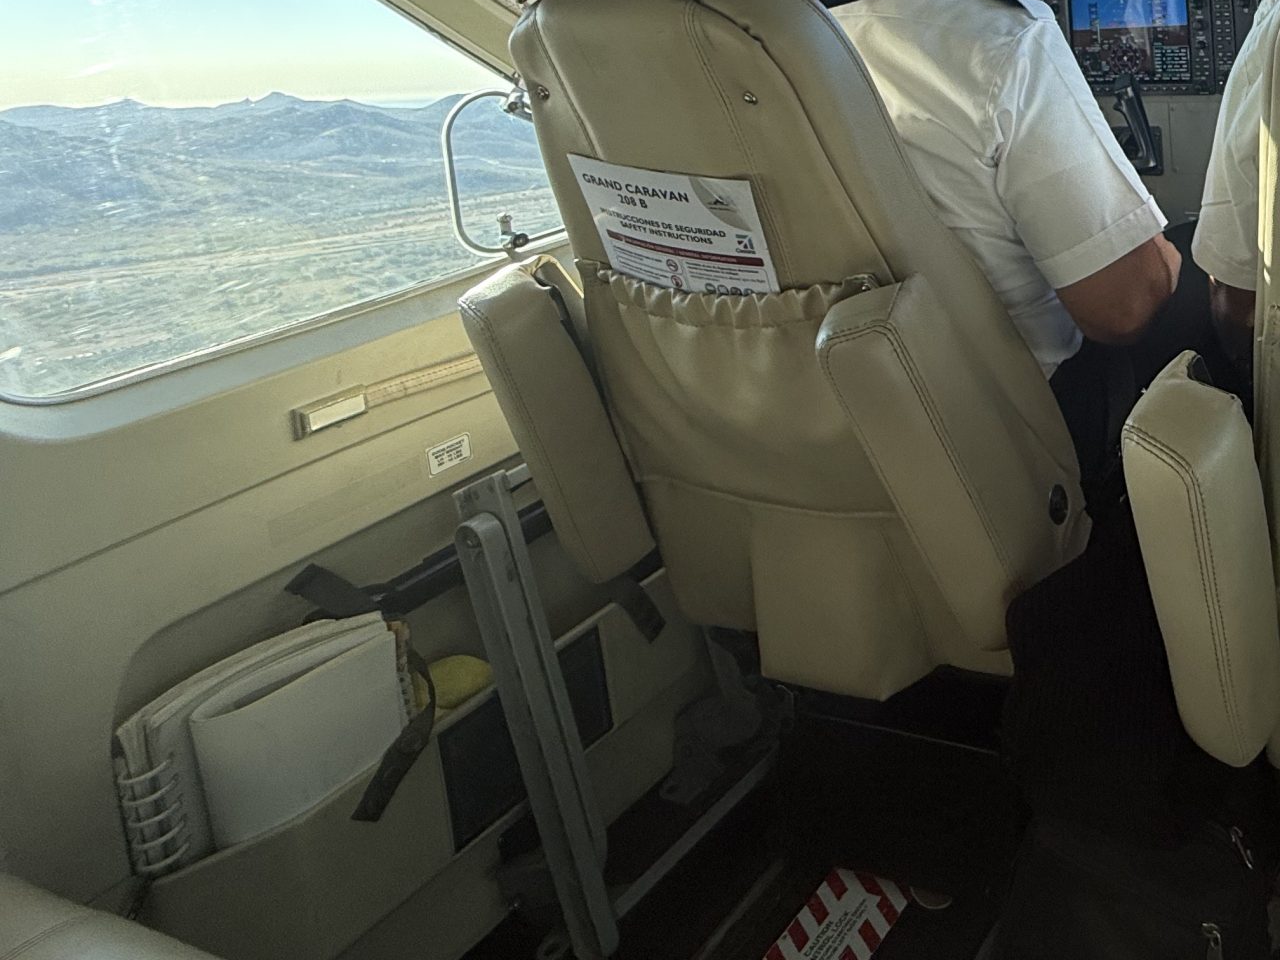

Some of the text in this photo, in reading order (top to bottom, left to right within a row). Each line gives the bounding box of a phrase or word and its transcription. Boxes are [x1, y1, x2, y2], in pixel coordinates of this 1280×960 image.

[582, 173, 690, 203] GRAND CARAVAN
[617, 194, 648, 209] 208 B
[620, 220, 713, 245] SAFETY INSTRUCTIONS
[662, 222, 674, 230] DE
[675, 224, 726, 238] SEGURIDAD
[804, 920, 834, 957] CAUTION
